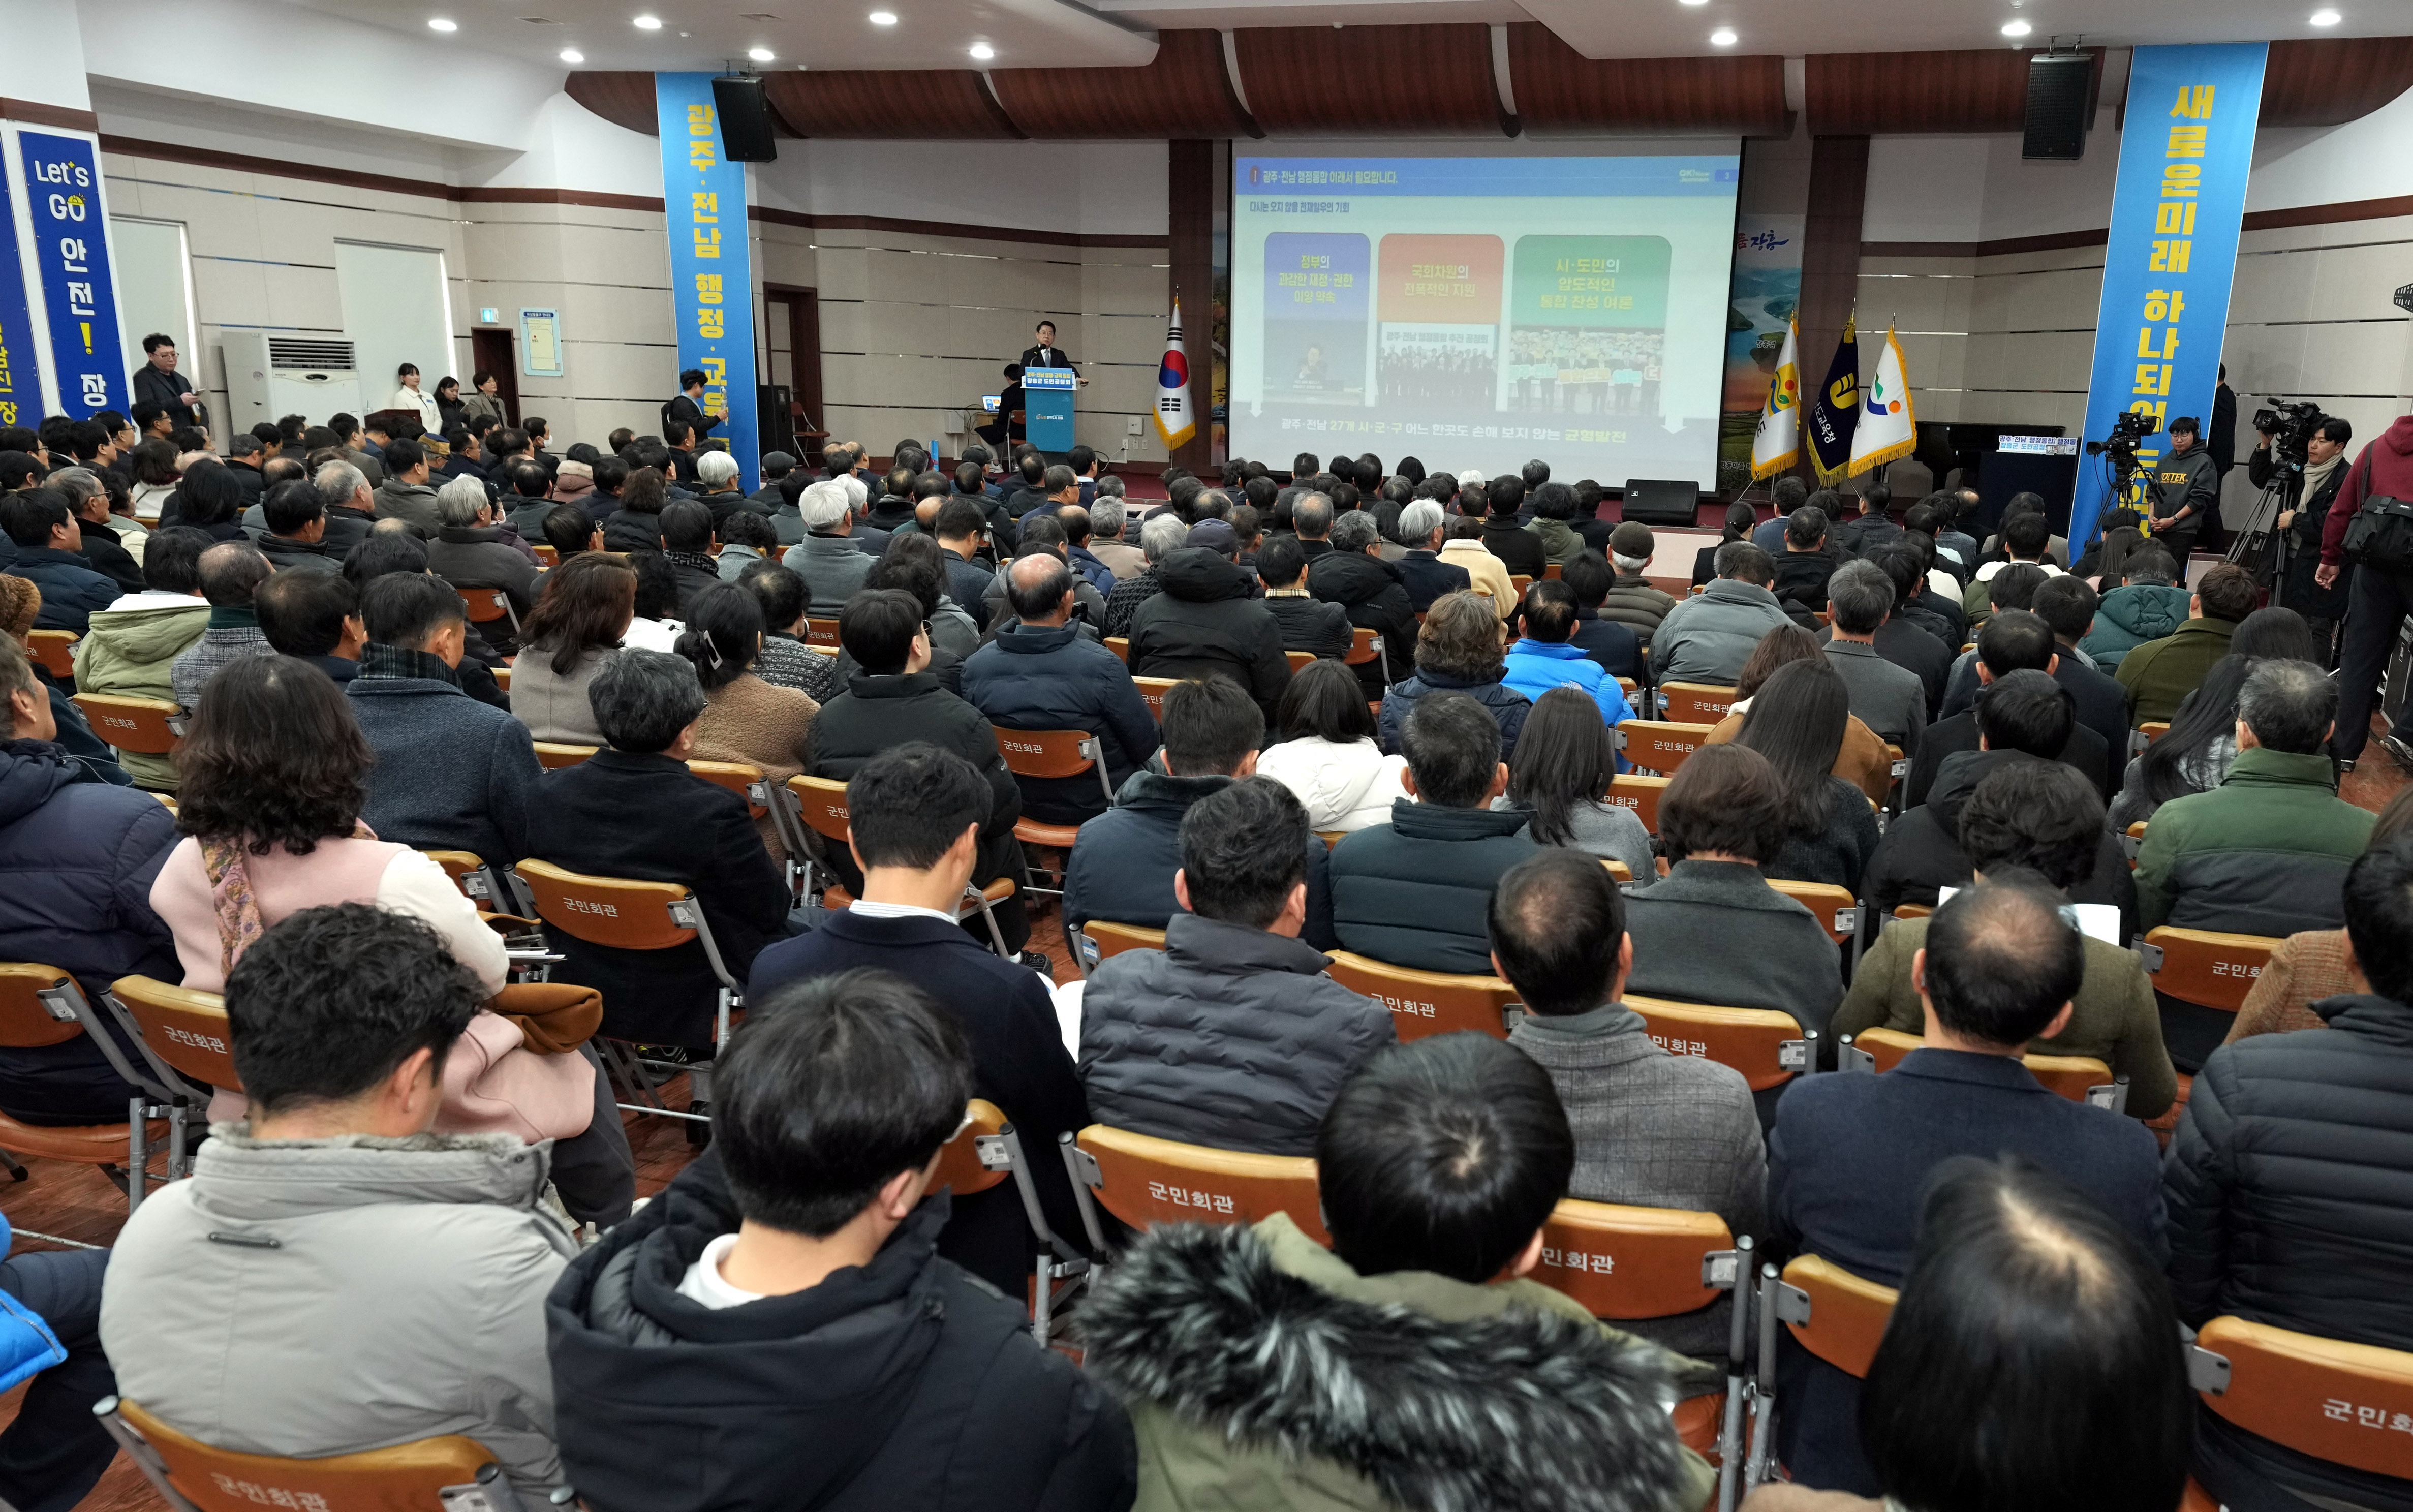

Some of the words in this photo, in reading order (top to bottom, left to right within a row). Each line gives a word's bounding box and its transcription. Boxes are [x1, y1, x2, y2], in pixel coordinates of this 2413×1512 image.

[34, 160, 89, 187] Let's
[687, 104, 722, 258] 광주·전남
[1263, 170, 1296, 183] 광주·전남
[1297, 170, 1328, 184] 행정통합
[1329, 171, 1353, 183] 이래서
[1355, 171, 1398, 184] 필요합니다.
[49, 193, 86, 222] GO
[1250, 201, 1269, 212] 다시는
[1271, 201, 1283, 212] 오지
[1285, 202, 1298, 212] 않을
[1300, 202, 1334, 213] 천재일우의
[1336, 202, 1349, 213] 기회
[1750, 230, 1789, 251] 장흥
[1301, 255, 1330, 269] 정부의
[1556, 259, 1620, 273] 시·도민의
[1279, 272, 1307, 287] 과감한
[1309, 273, 1353, 288] 재정·권한
[1411, 264, 1469, 280] 국회차원의
[1405, 283, 1448, 297] 전폭적인
[1452, 283, 1476, 298] 지원
[1558, 277, 1615, 292] 압도적인
[60, 237, 95, 354] 안전!
[1294, 290, 1313, 303] 이양
[1316, 290, 1336, 304] 약속
[1540, 294, 1568, 309] 통합
[1571, 296, 1599, 309] 찬성
[1603, 296, 1633, 310] 여론
[1755, 340, 1776, 349] 장흥댐
[1281, 418, 1327, 431] 광주·전남
[1329, 420, 1355, 432] 27개
[1358, 421, 1402, 434] 시·군·구
[1406, 423, 1428, 435] 어느
[1472, 425, 1498, 438] 손해
[1501, 426, 1528, 439] 보지
[1533, 427, 1560, 441] 않는
[1565, 429, 1626, 443] 균형발전
[807, 630, 834, 640] 군민회관
[1693, 701, 1729, 714] 군민회관
[102, 716, 137, 730] 군민회관
[1003, 740, 1043, 754] 군민회관
[1654, 740, 1694, 753] 군민회관
[1601, 795, 1639, 809] 민회관
[563, 897, 618, 917] 군민회관
[163, 1025, 229, 1054] 군민회관
[1649, 1034, 1707, 1057] 민회관
[1149, 1180, 1234, 1214] 군민회관
[1541, 1246, 1615, 1274] 민회관
[210, 1472, 330, 1512] 군민회관
